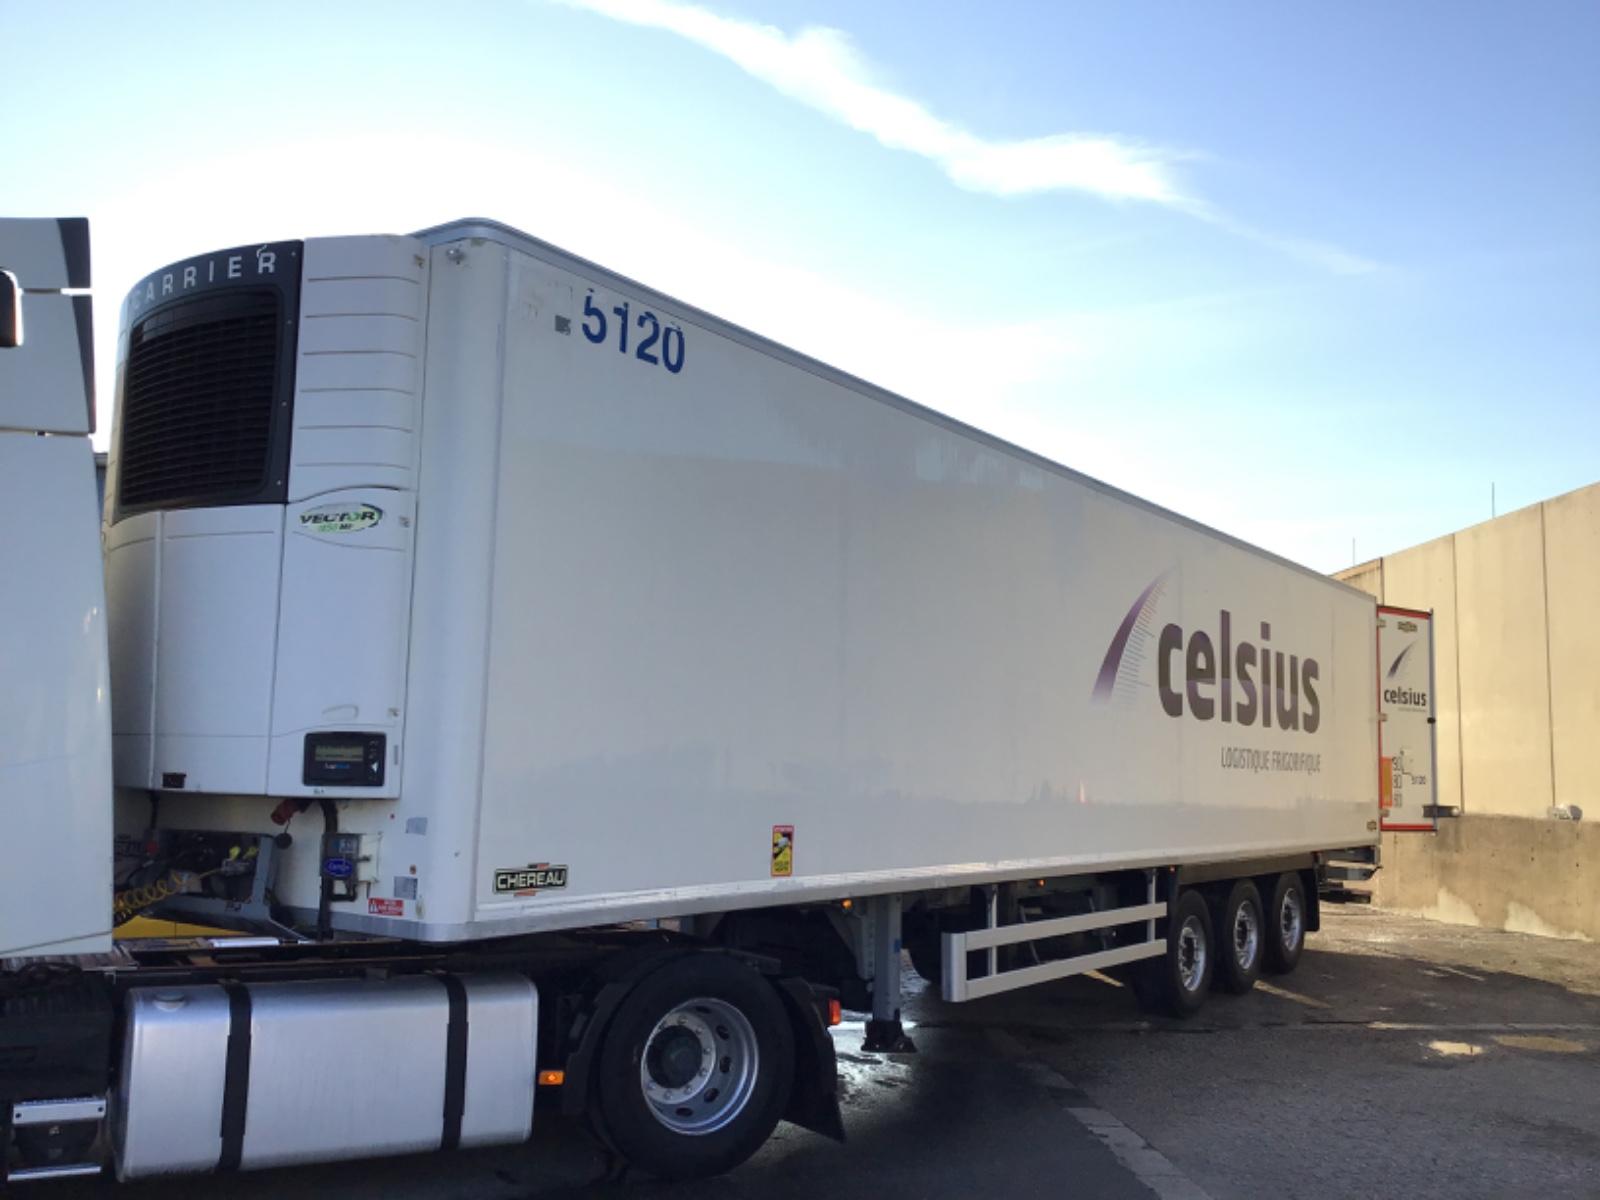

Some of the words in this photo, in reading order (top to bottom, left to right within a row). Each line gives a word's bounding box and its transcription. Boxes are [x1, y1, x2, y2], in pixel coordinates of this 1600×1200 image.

[581, 288, 685, 374] 5120
[300, 511, 375, 524] VECTOR
[1158, 609, 1320, 734] celsius
[1384, 686, 1427, 706] celsius
[1221, 747, 1270, 773] LOGISTIQUE
[497, 870, 565, 889] CHEREAU
